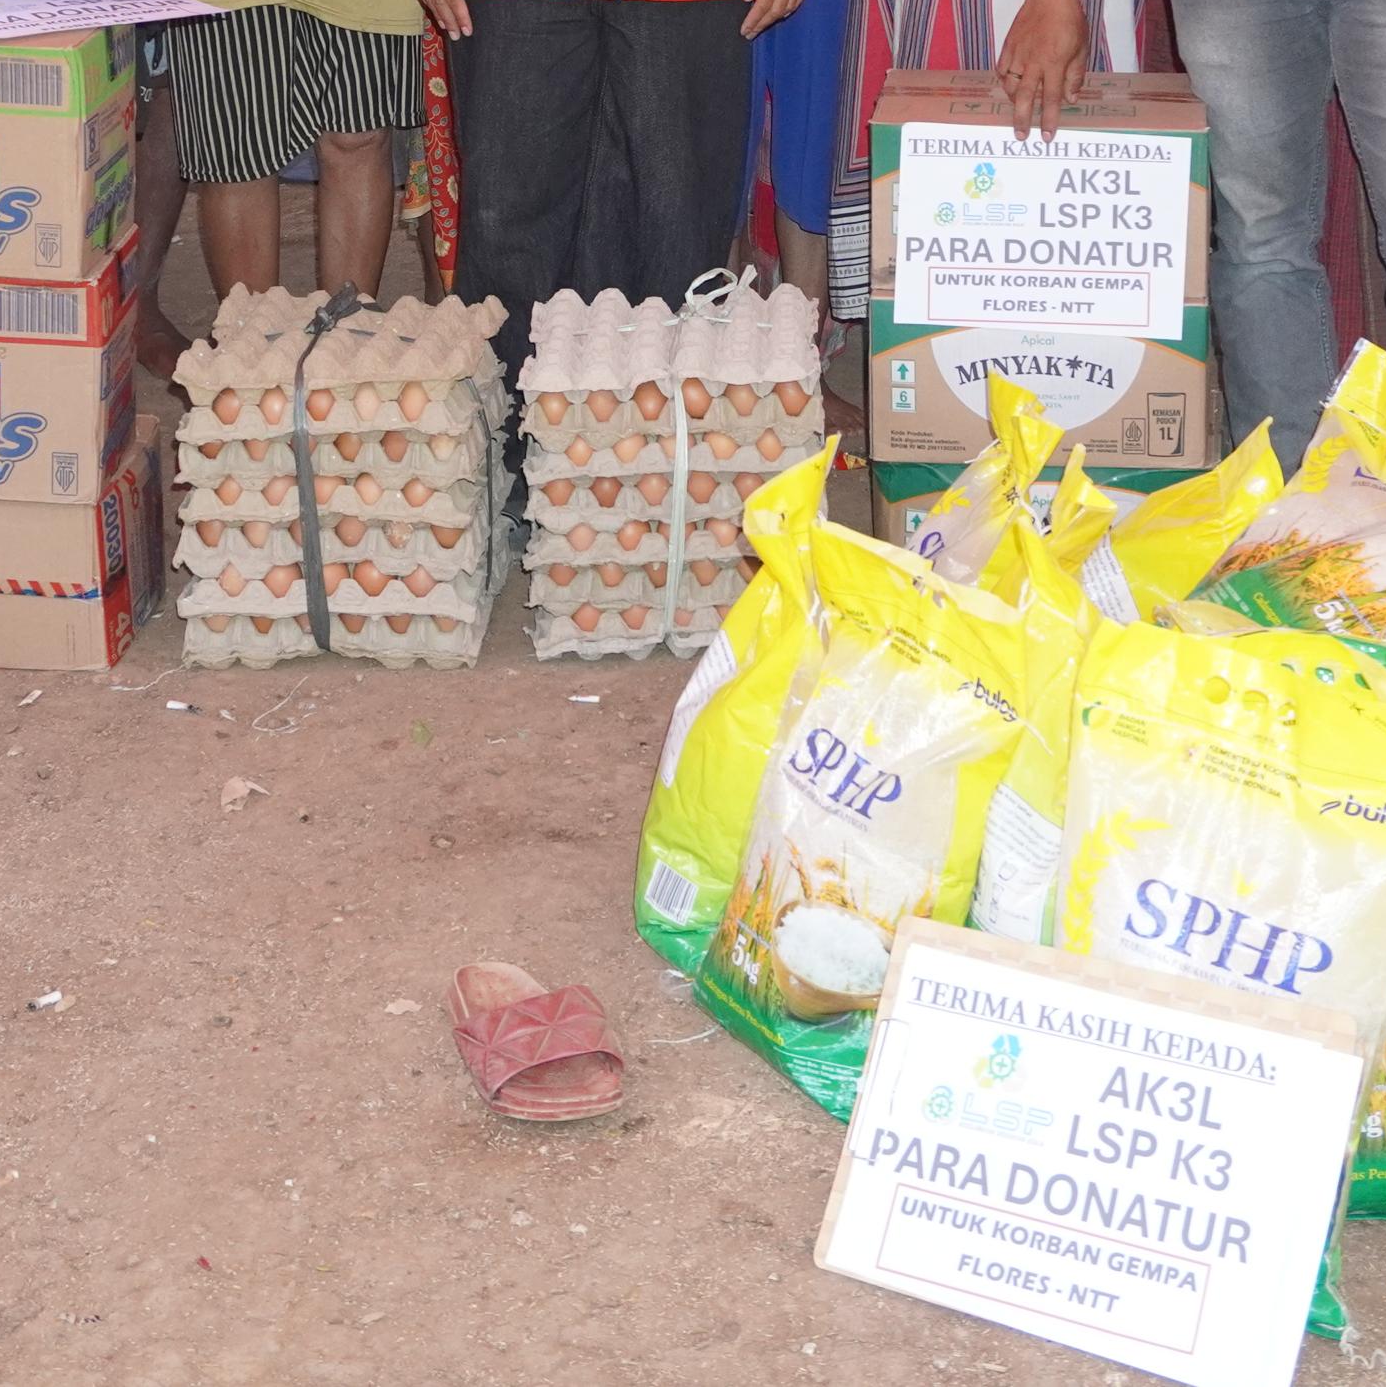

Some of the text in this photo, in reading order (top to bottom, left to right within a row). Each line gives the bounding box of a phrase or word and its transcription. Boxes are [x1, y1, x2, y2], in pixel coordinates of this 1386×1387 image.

[31, 0, 190, 20] DONATUR
[908, 137, 1172, 161] TERIMA KASIH KEPADA:
[1054, 168, 1141, 196] AK3L
[1039, 202, 1153, 230] LSP K3
[905, 237, 1174, 268] PARA DONATUR
[934, 273, 1144, 291] UNTUK KORBAN GEMPA
[982, 299, 1048, 312] FLORES
[1060, 300, 1095, 314] NTT
[1020, 334, 1056, 349] Apical
[899, 390, 908, 403] 6
[1152, 409, 1181, 417] KEMASAN
[972, 676, 1018, 723] bulog
[787, 727, 903, 821] SPHP
[1123, 877, 1334, 997] SPHP
[911, 975, 1277, 1082] TERIMA KASIH KEPADA:
[1098, 1066, 1223, 1131] AK3L
[1066, 1114, 1158, 1170] LSP
[1169, 1137, 1233, 1193] K3
[867, 1127, 1252, 1264] PARA DONATUR
[899, 1196, 1199, 1293] UNTUK KORBAN GEMPA
[957, 1254, 1051, 1296] FLORES
[1068, 1283, 1121, 1314] NTT
